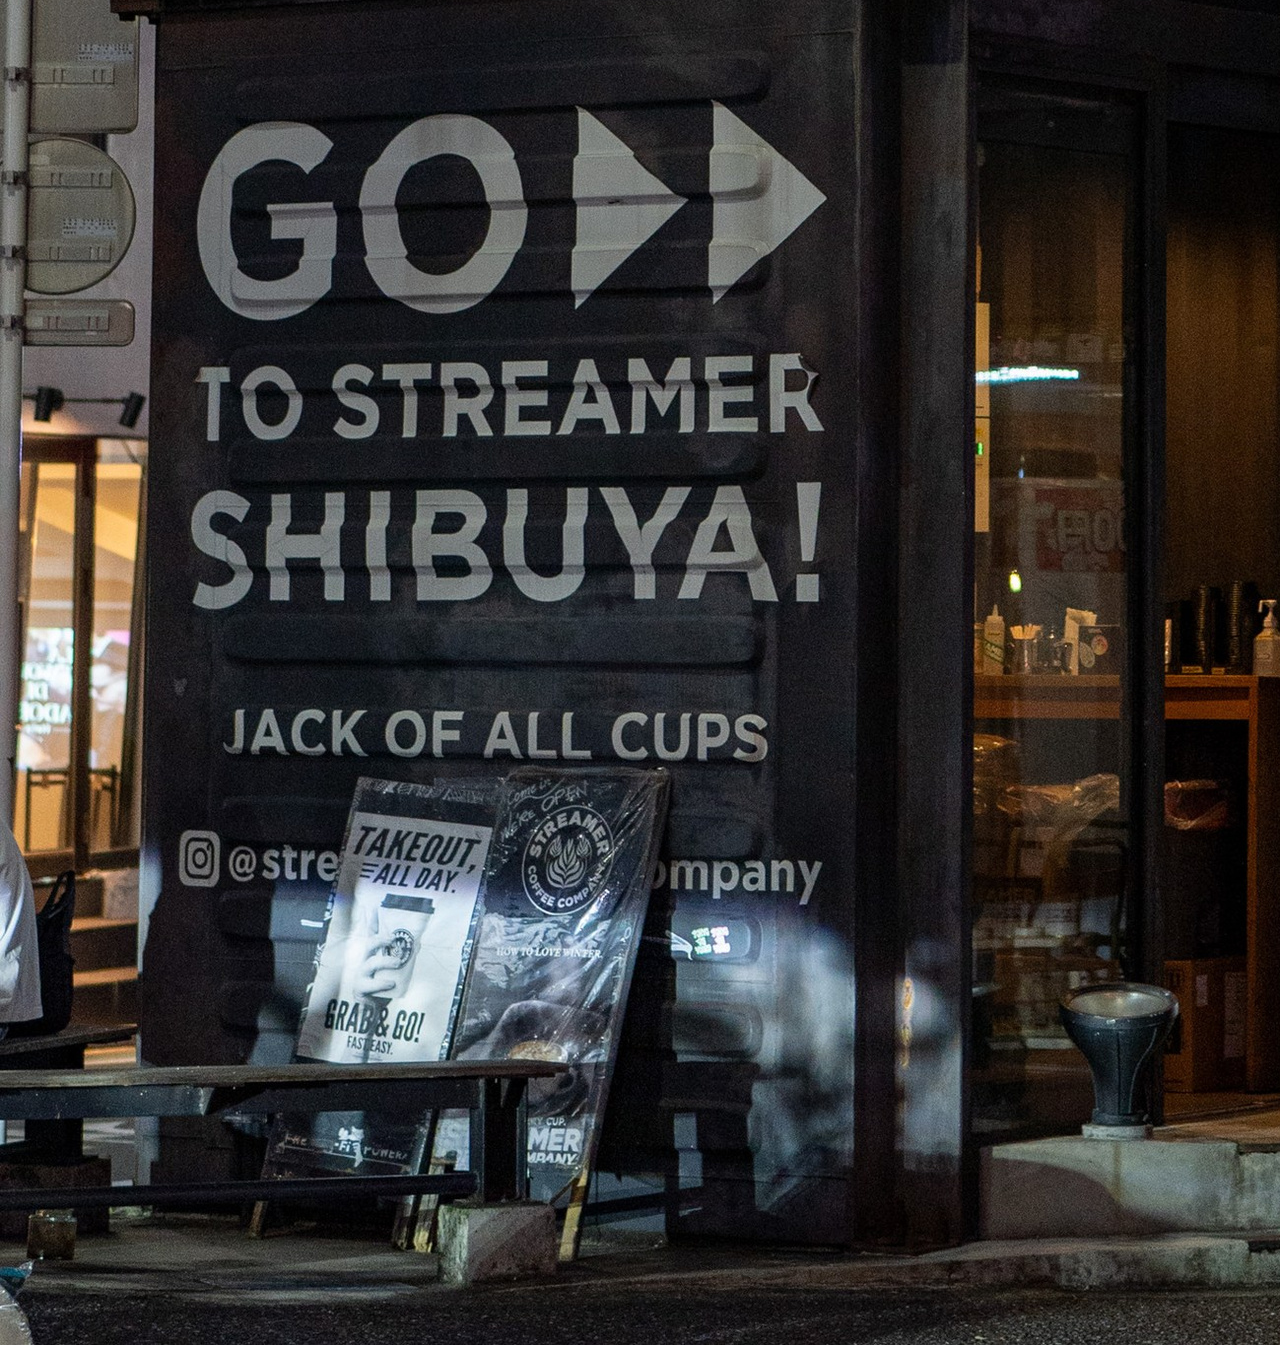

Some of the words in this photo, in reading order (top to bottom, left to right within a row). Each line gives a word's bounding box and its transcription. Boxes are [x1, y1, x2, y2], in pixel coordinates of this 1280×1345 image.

[196, 113, 528, 321] GO
[195, 363, 302, 442] TO
[331, 351, 825, 440] STREAMER
[190, 481, 822, 610] SHIBUYA!
[222, 708, 370, 757] JACK
[384, 709, 465, 759] OF
[481, 710, 592, 760] ALL
[611, 711, 770, 763] CUPS
[541, 779, 589, 812] OPEN
[353, 824, 482, 875] TAKEOUT,
[528, 810, 611, 859] STREAMER
[372, 862, 409, 888] ALL
[414, 867, 459, 894] DAY.
[527, 864, 556, 908] COFFEE
[535, 947, 563, 958] LOVE
[324, 998, 374, 1034] GRAB
[373, 1007, 390, 1038] &
[392, 1009, 426, 1044] GO!
